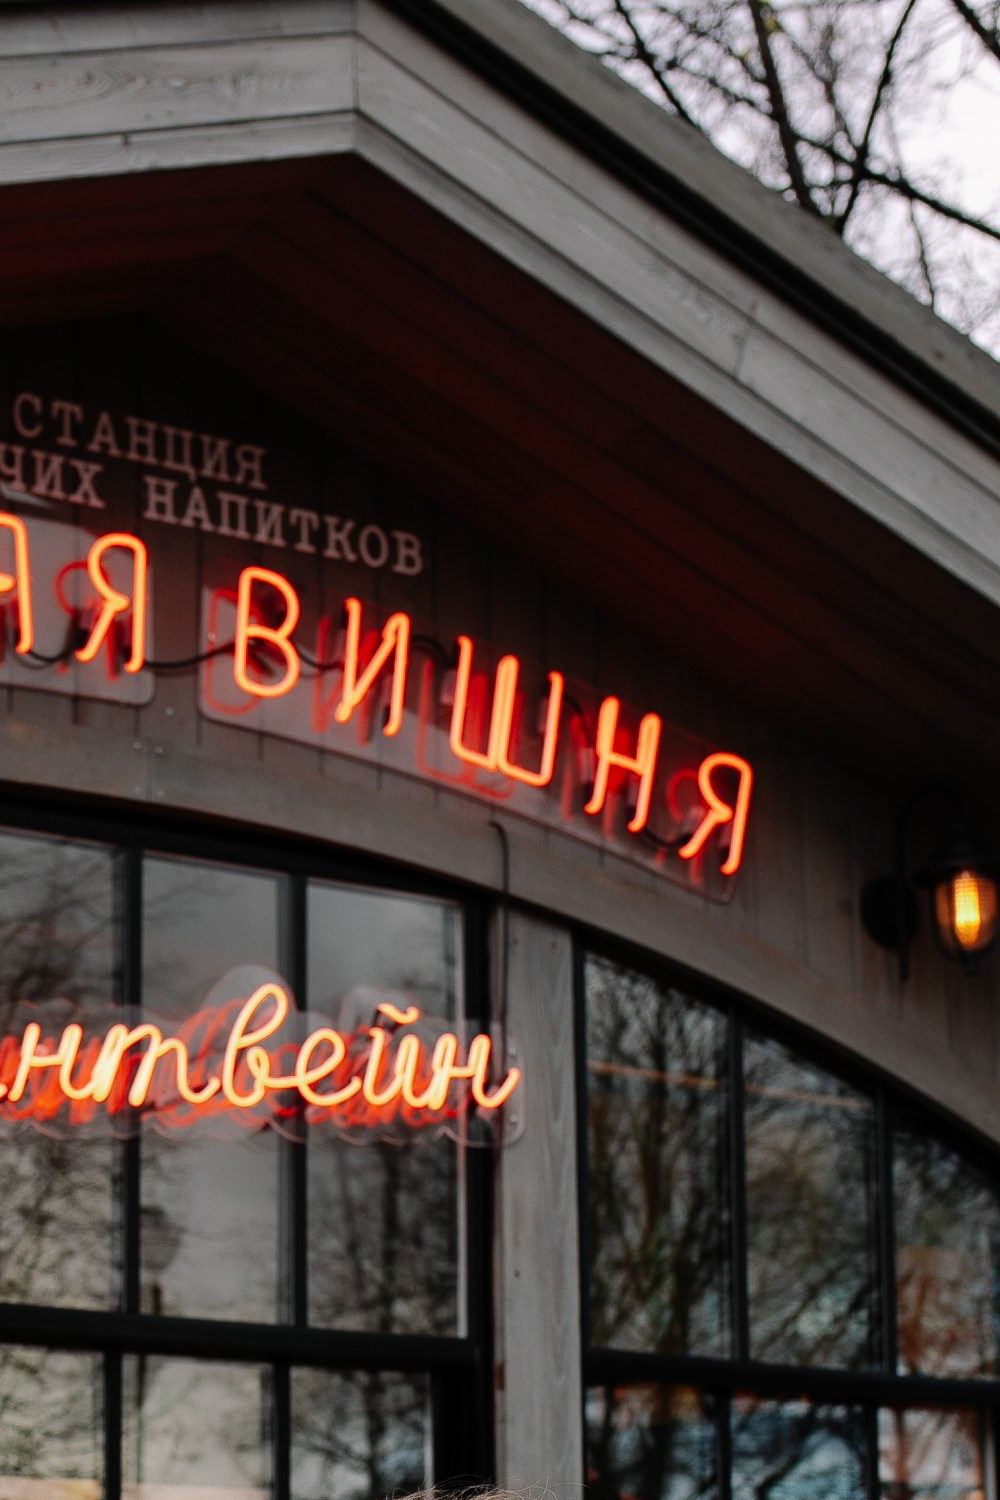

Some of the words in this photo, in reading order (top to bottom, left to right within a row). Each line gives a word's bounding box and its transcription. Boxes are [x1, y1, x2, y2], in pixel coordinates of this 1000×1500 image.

[12, 391, 268, 490] СТАНЦИЯ
[143, 474, 424, 576] НАПИТКОВ
[233, 565, 753, 875] ВИШНЯ
